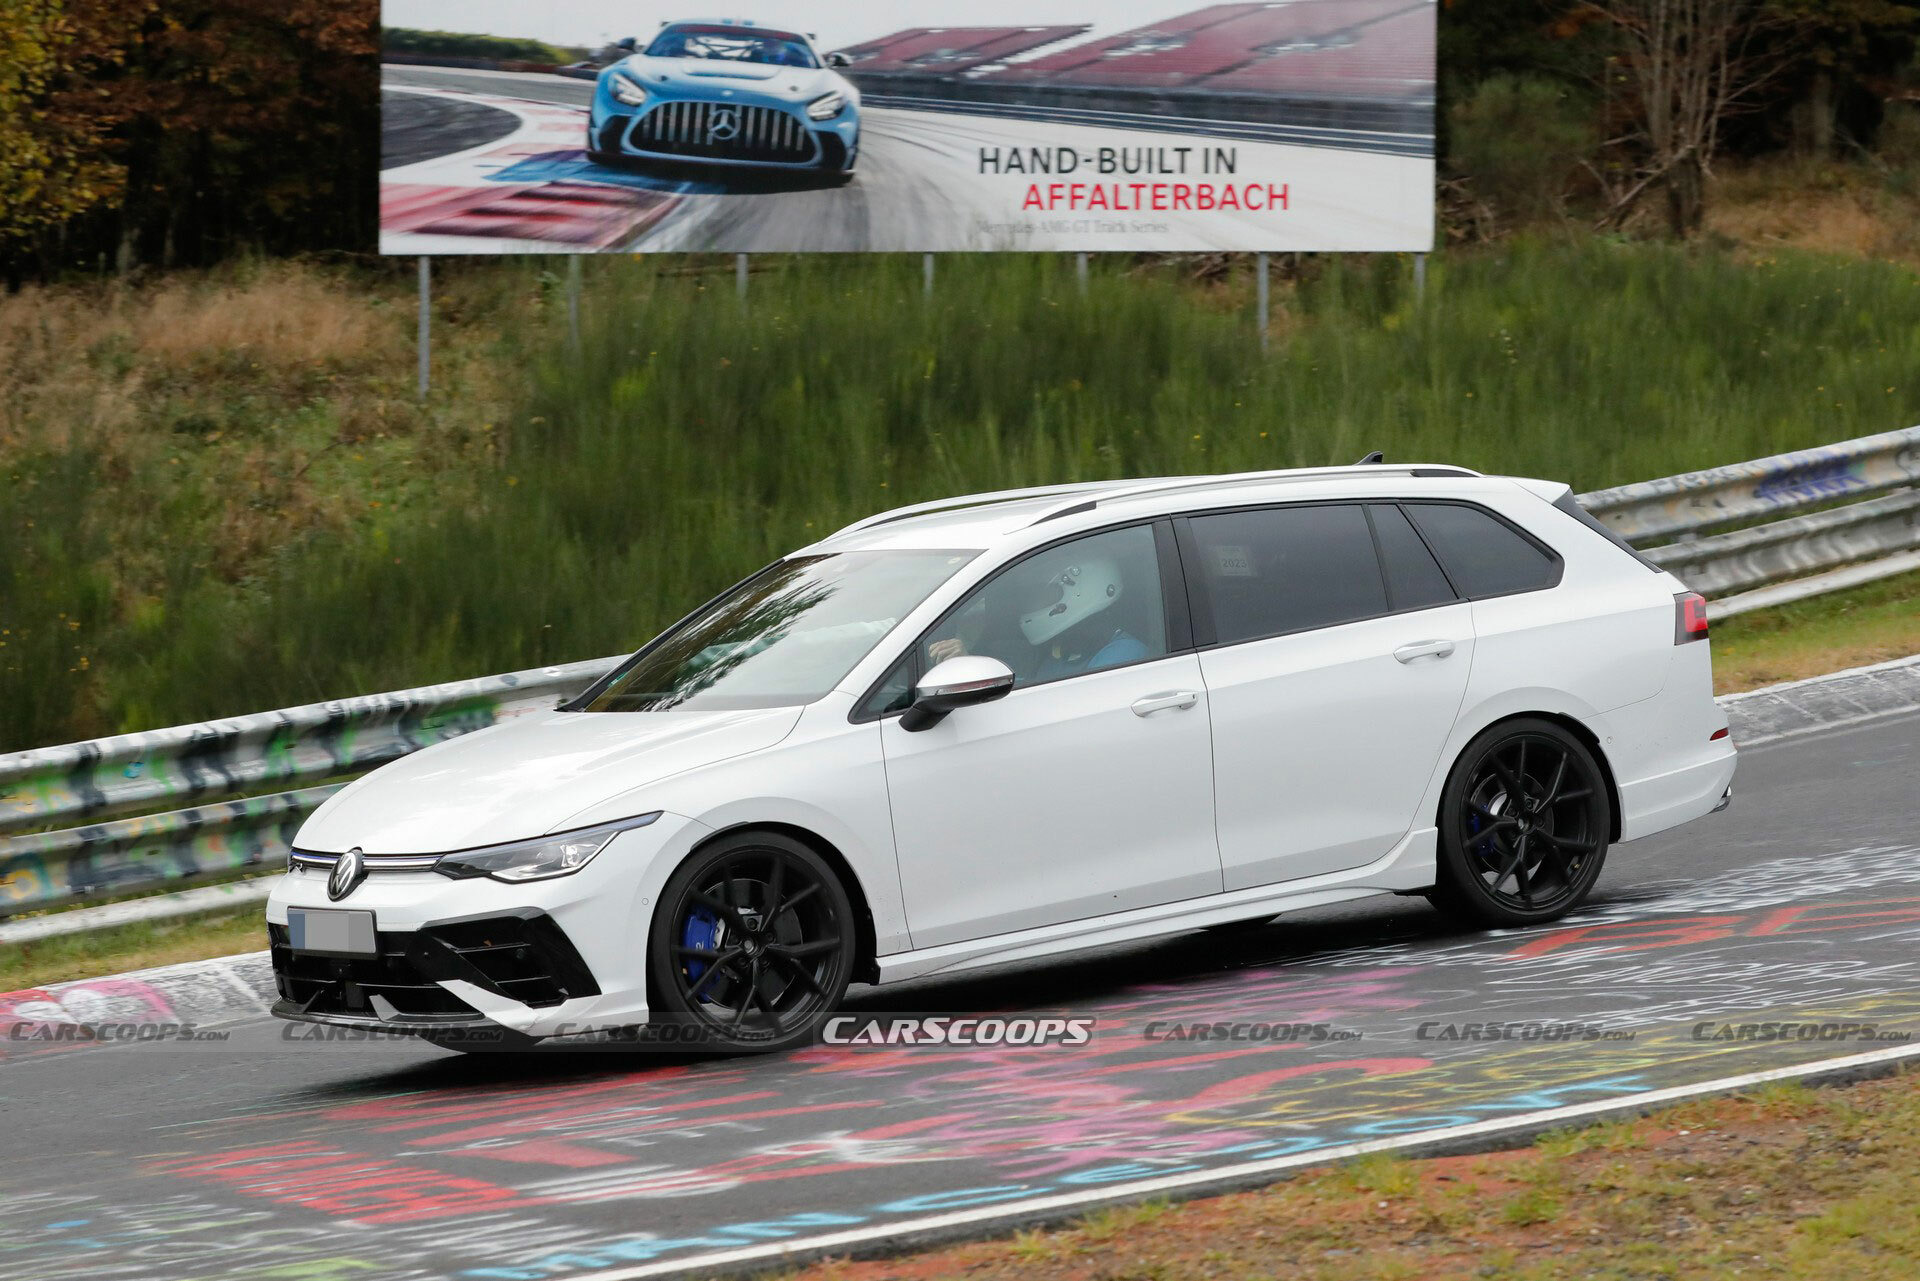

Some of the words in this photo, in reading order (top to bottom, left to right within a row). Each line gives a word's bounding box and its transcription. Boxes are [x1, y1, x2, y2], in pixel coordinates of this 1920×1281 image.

[978, 147, 1192, 174] HAND-BUILT
[1202, 147, 1237, 174] IN
[1022, 184, 1289, 210] AFFALTERBACH
